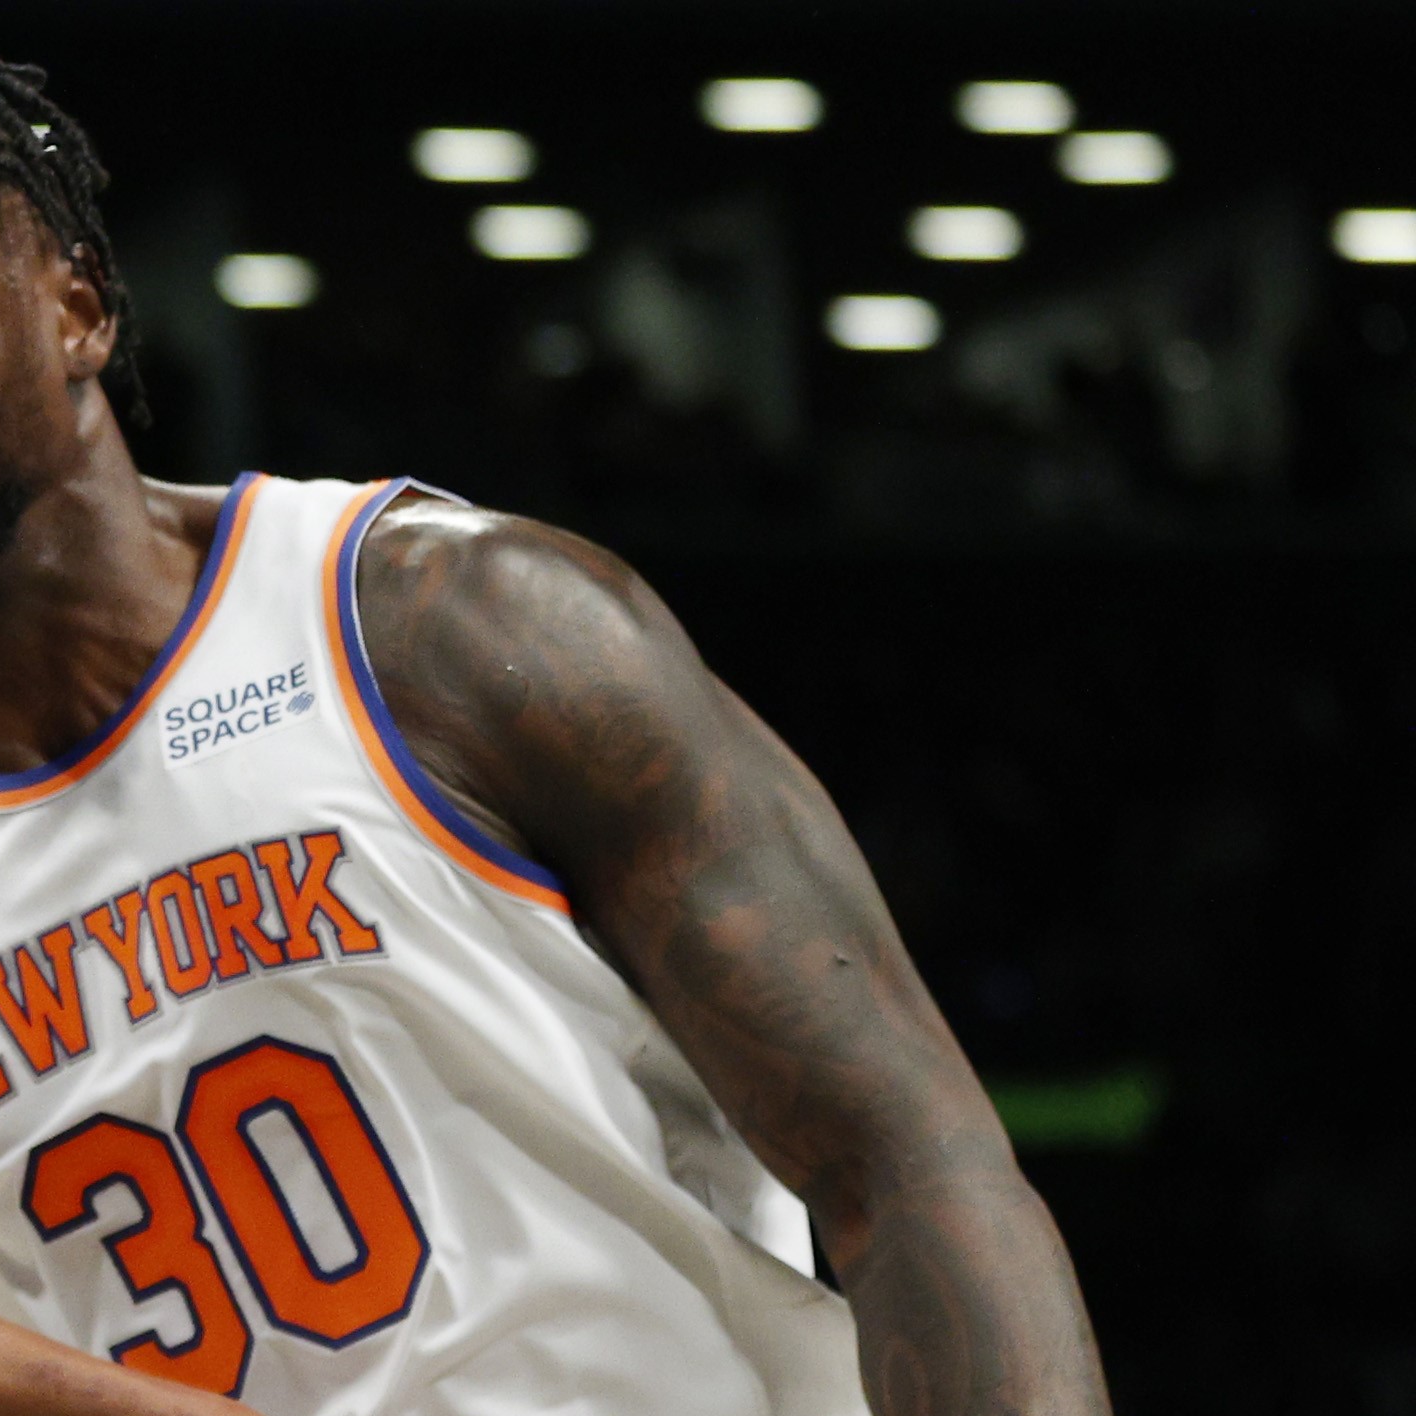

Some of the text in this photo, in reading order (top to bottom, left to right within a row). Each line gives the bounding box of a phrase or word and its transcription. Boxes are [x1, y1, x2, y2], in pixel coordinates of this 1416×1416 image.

[165, 662, 307, 731] SQUARE
[168, 702, 282, 760] SPACE
[82, 828, 385, 1025] YORK
[20, 1034, 431, 1400] 30
